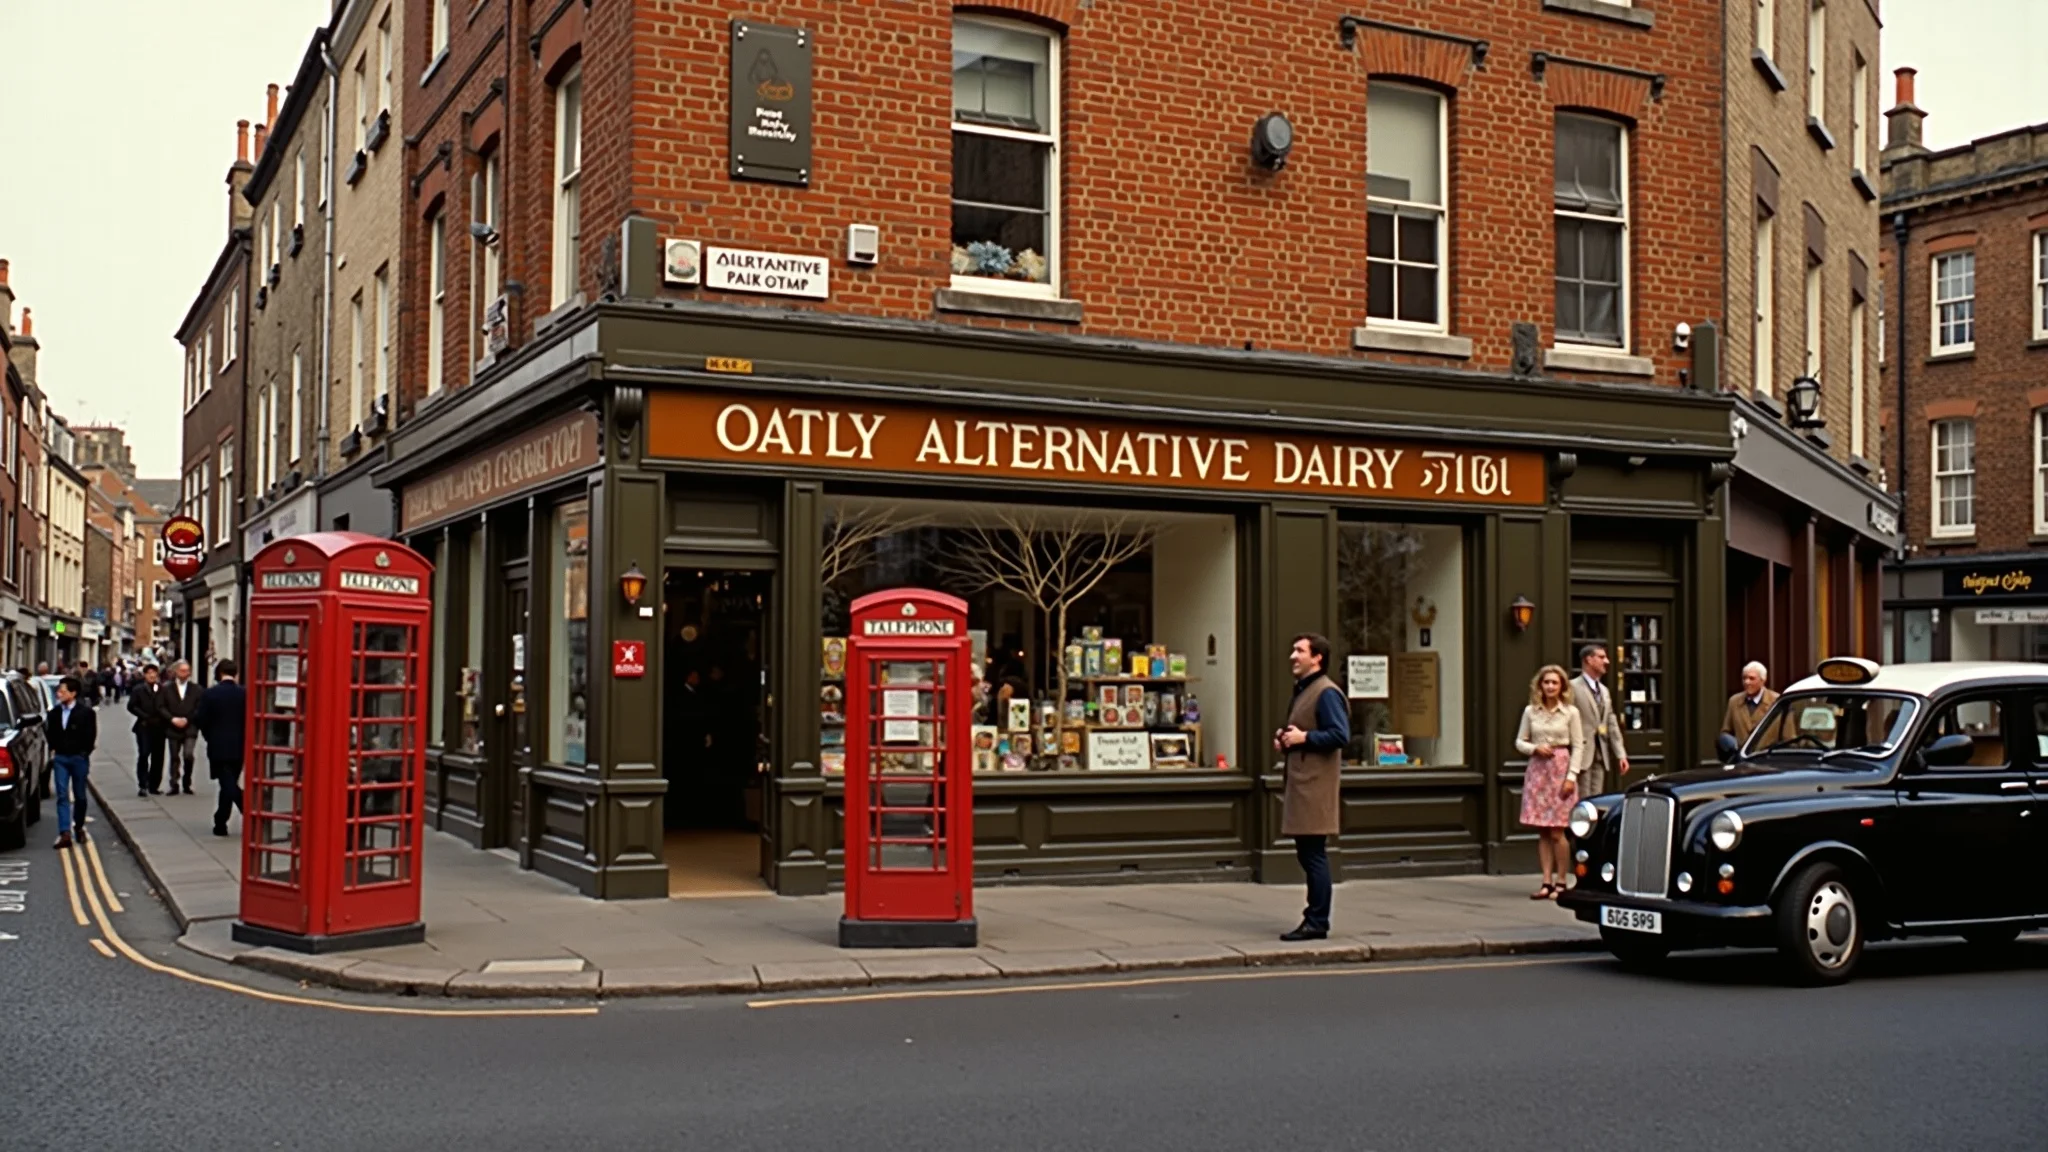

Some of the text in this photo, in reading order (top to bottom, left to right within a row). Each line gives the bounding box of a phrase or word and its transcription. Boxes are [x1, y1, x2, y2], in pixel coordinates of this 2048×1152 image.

[716, 404, 886, 459] OATLY
[915, 418, 1250, 482] ALTERNATIVE
[1274, 441, 1403, 489] DAIRY
